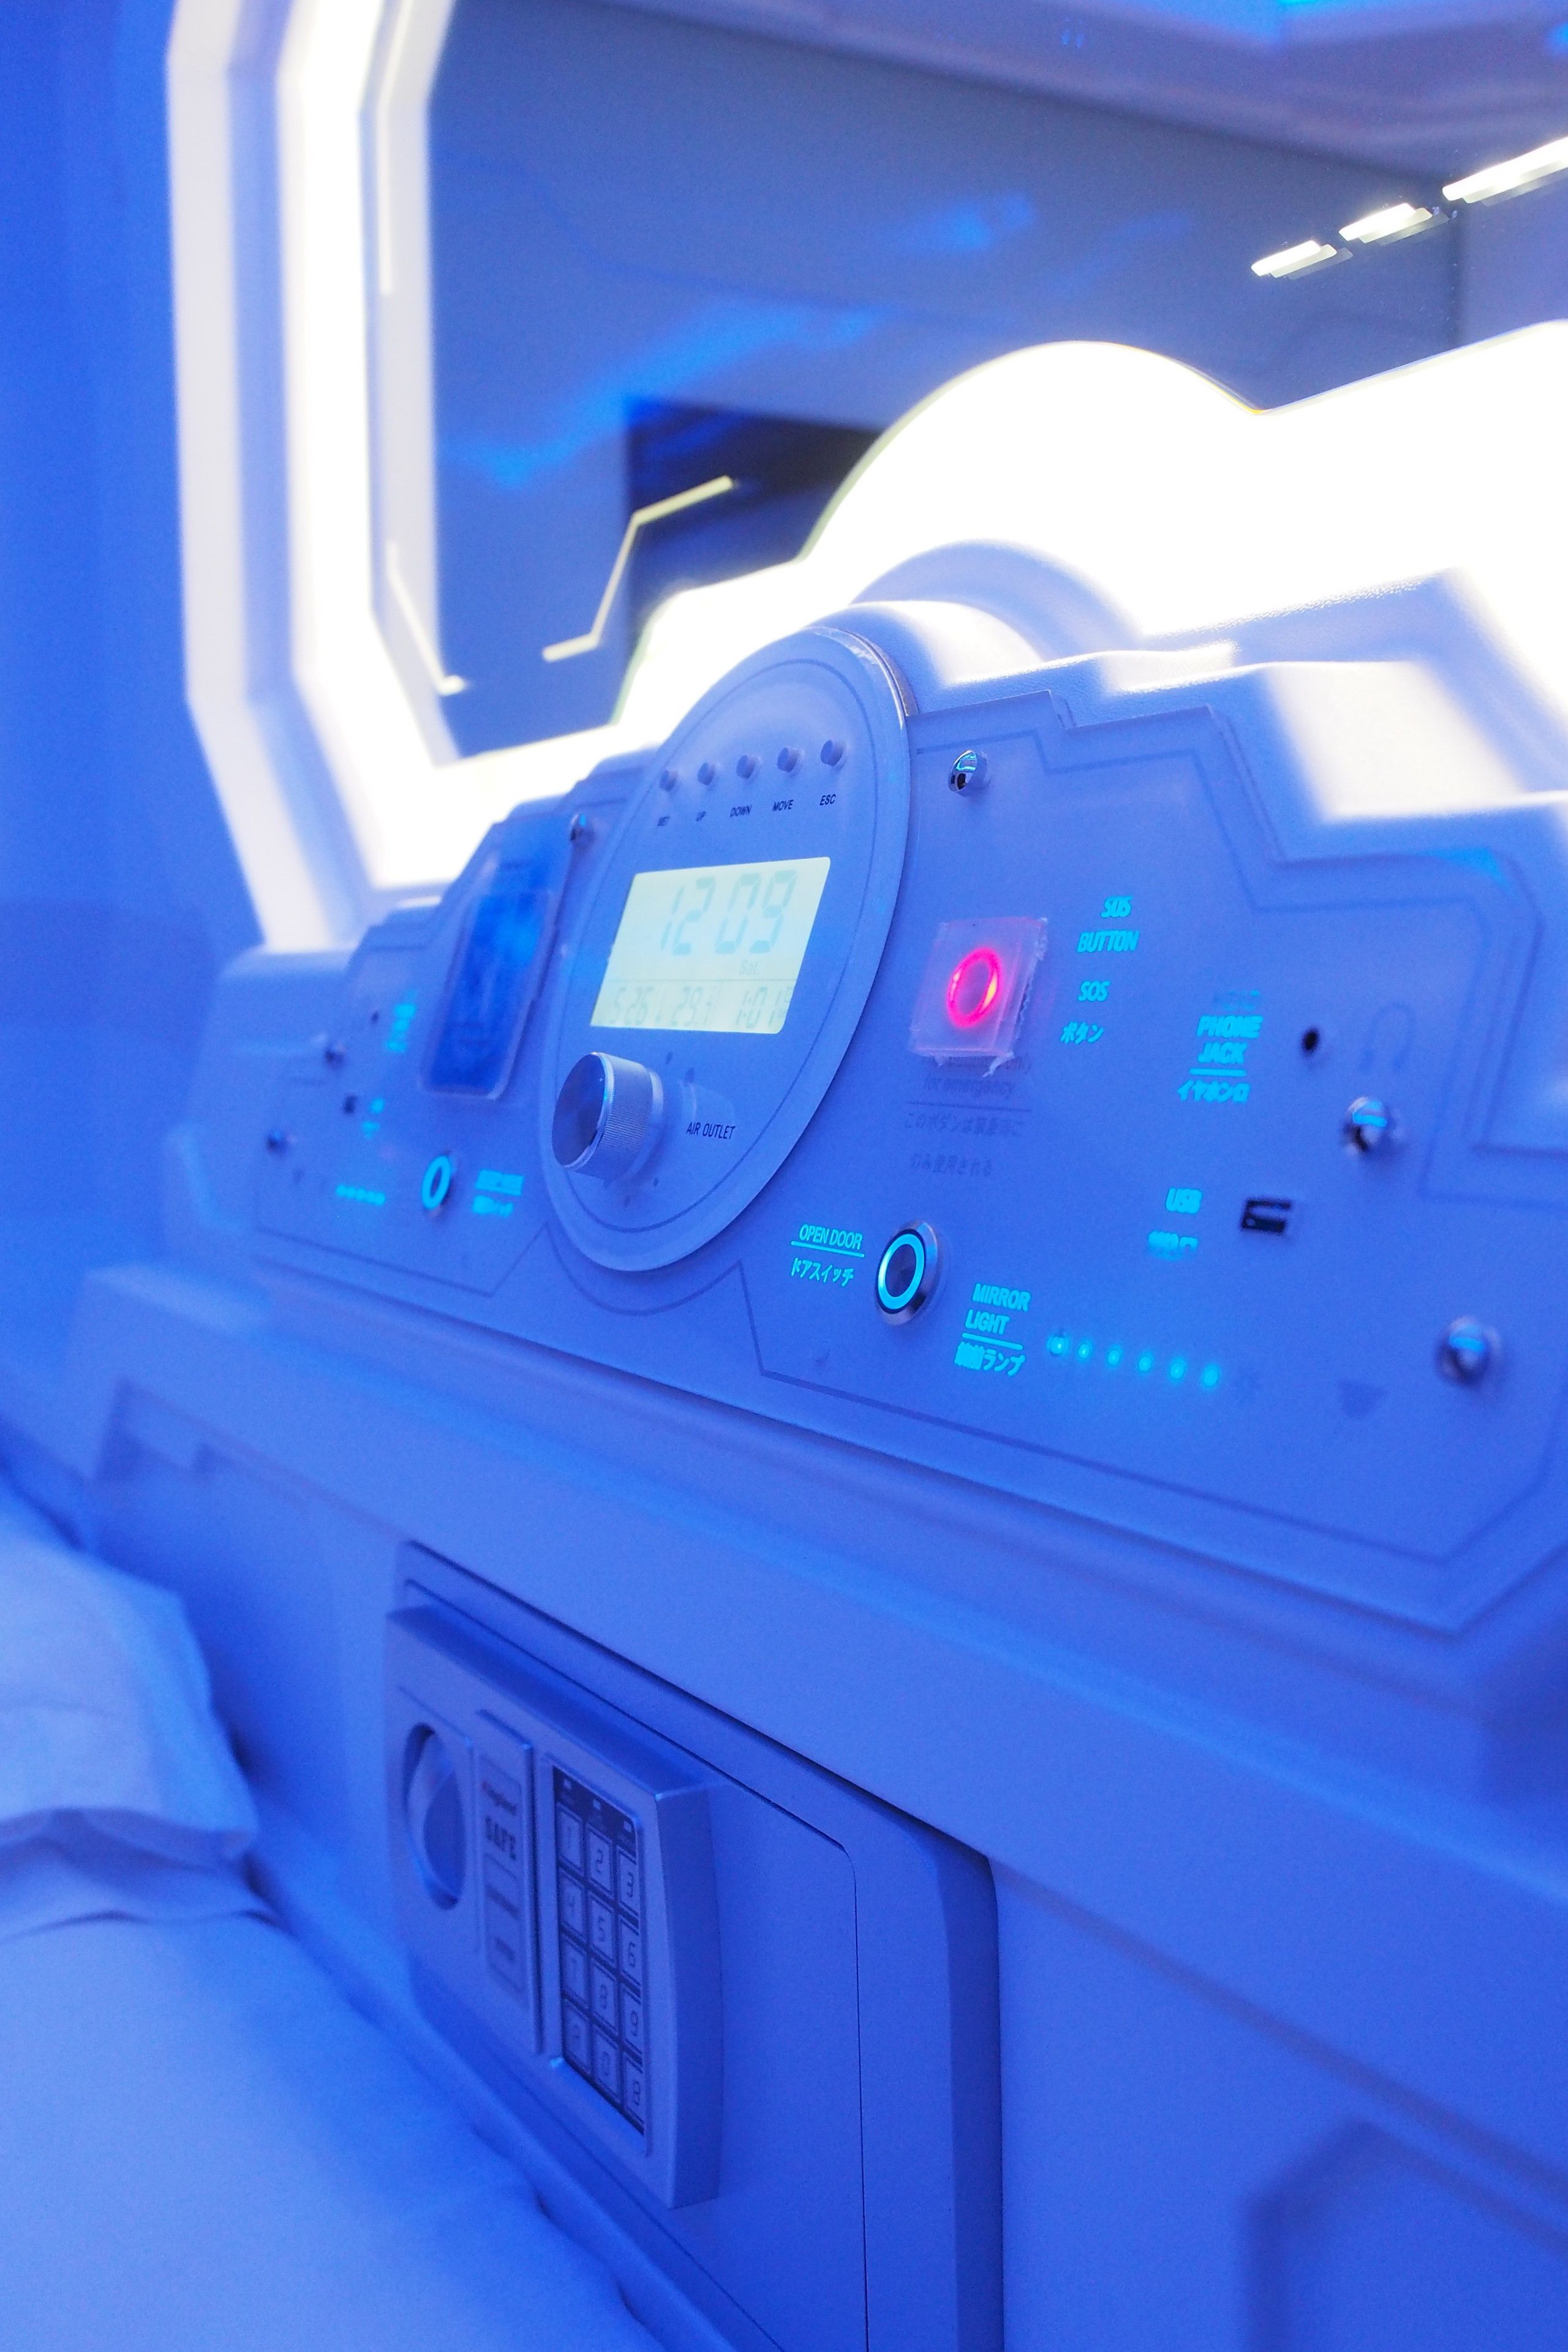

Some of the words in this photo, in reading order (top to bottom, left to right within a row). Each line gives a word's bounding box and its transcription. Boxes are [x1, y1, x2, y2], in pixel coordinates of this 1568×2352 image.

[729, 805, 753, 818] DOWN
[772, 799, 794, 812] MOVE
[820, 794, 837, 806] ESC
[1101, 895, 1133, 918] SOS
[1077, 929, 1140, 952] BUTTON
[1077, 980, 1111, 1002] SOS
[1060, 1020, 1104, 1044] ボタン
[1196, 1014, 1264, 1039] PHONE
[1197, 1041, 1248, 1065] JACK
[686, 1121, 701, 1136] AIR
[702, 1123, 736, 1140] OUTLET
[1165, 1186, 1204, 1215] USB
[799, 1223, 831, 1245] OPEN
[829, 1228, 864, 1251] DOOR
[791, 1257, 854, 1287] ドアスイッチ
[971, 1283, 1031, 1312] MIRROR
[965, 1308, 1011, 1335] LIGHT
[596, 1847, 603, 1876] 2
[626, 1870, 635, 1899] 3
[597, 1914, 605, 1943] 5
[627, 1939, 636, 1969] 6
[630, 2008, 639, 2038] 9
